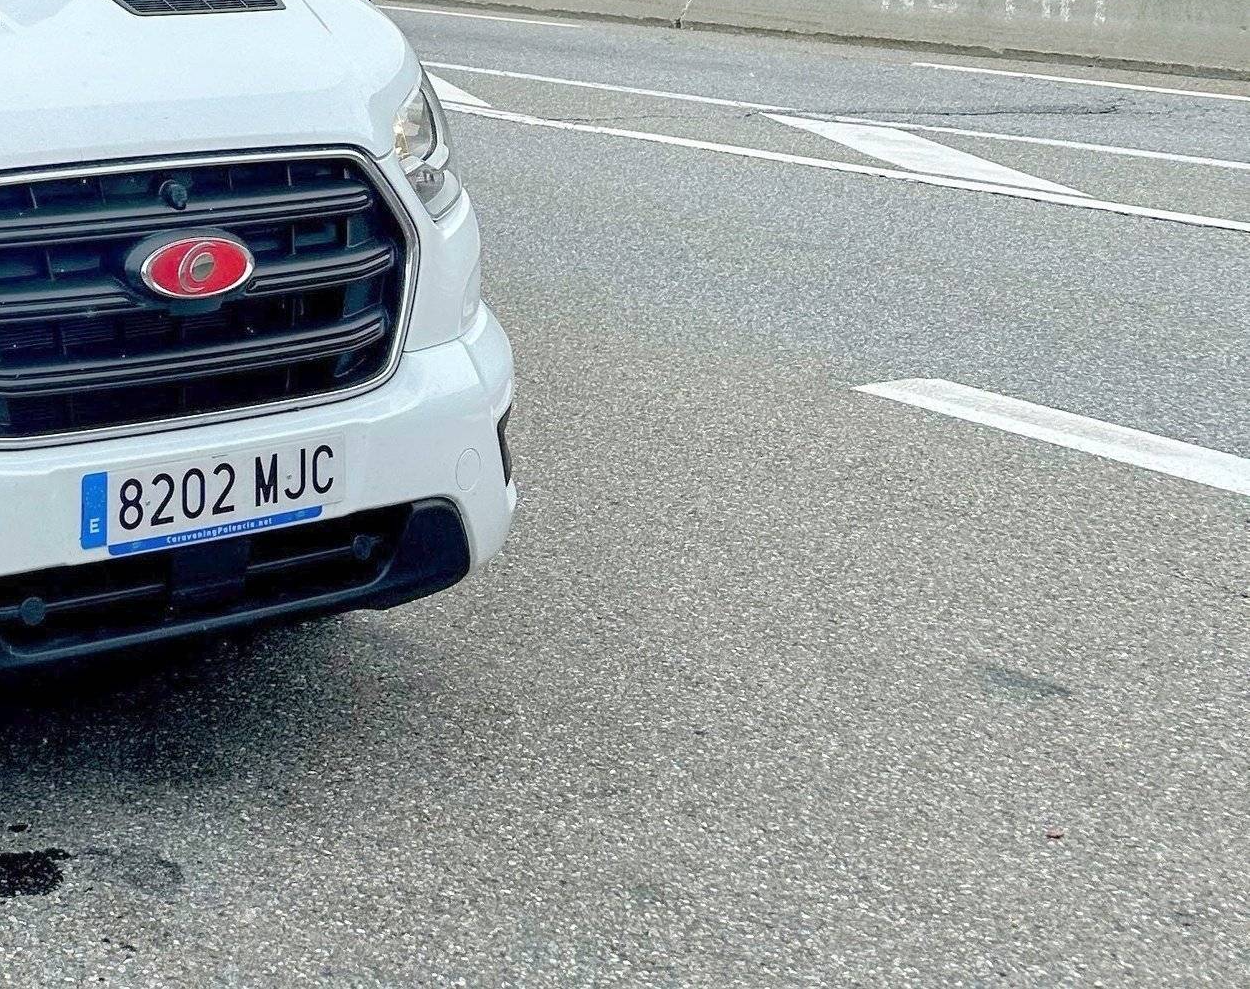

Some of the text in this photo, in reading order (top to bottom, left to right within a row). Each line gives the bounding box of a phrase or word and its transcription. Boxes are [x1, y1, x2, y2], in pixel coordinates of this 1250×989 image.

[118, 444, 334, 531] 8202 MJC
[88, 517, 100, 534] E
[166, 517, 273, 545] CaravaningPalencia.net
